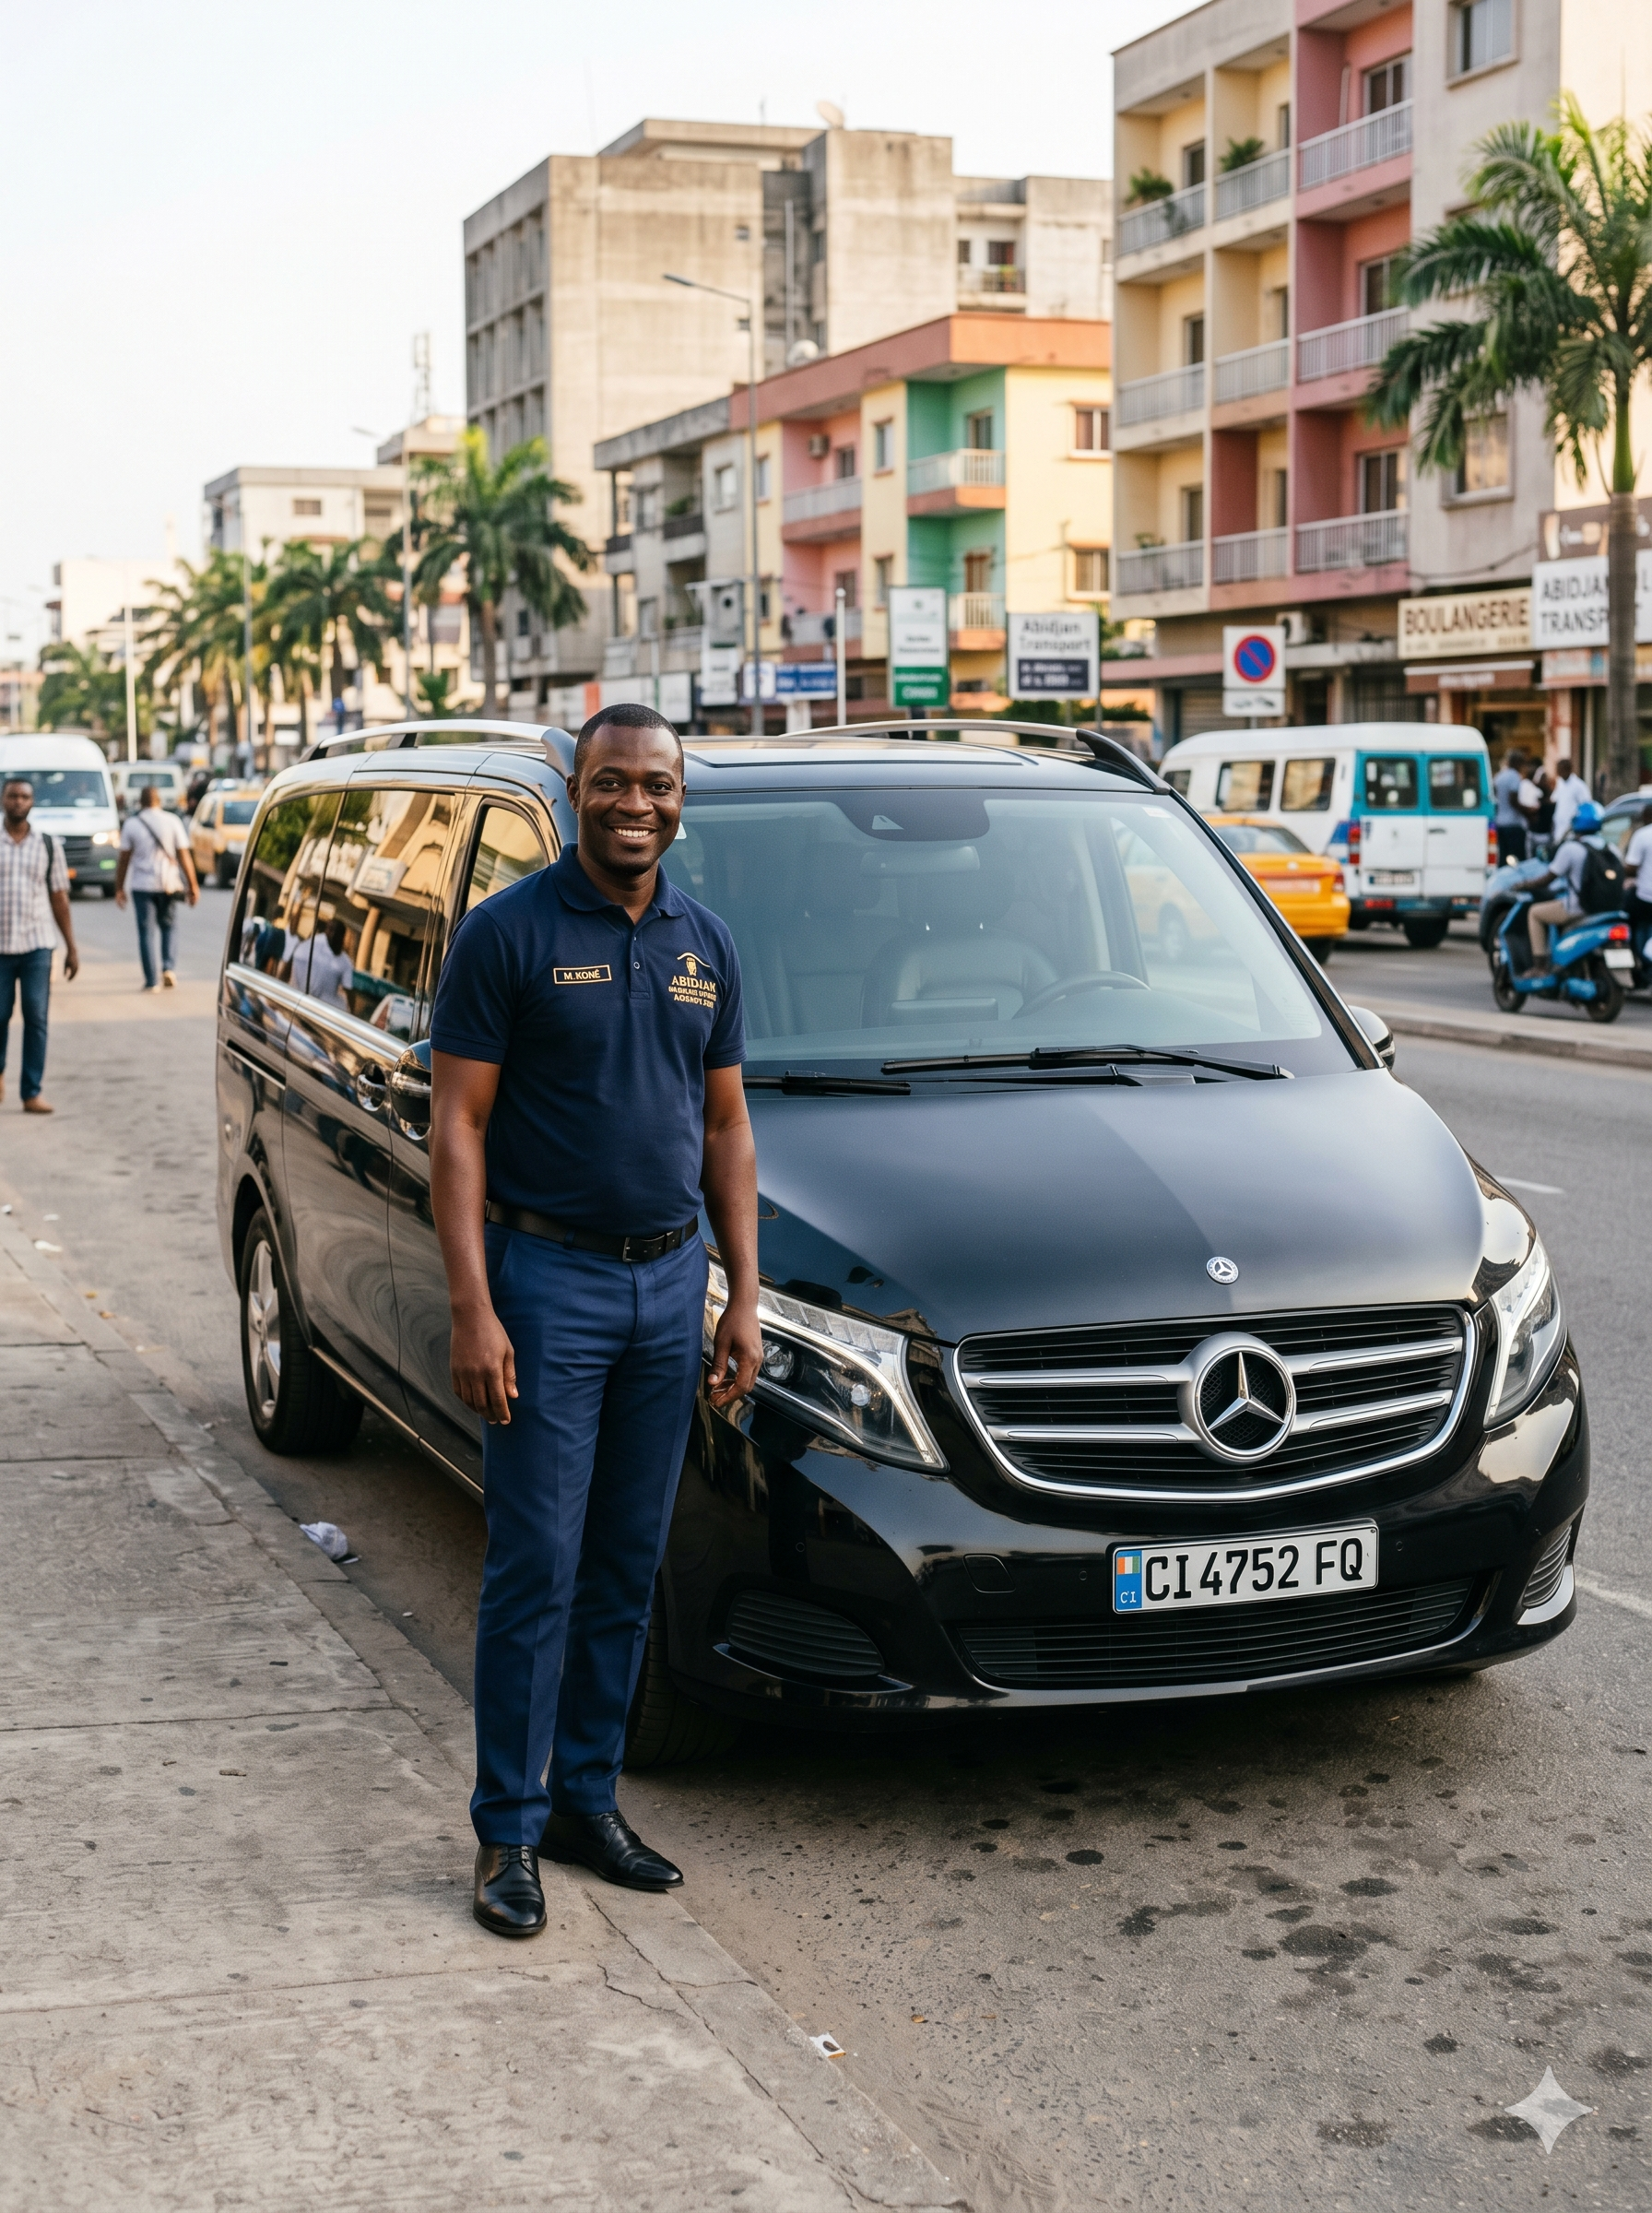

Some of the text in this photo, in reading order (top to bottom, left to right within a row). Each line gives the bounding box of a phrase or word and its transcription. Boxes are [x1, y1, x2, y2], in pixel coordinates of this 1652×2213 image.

[1541, 574, 1610, 602] ABIDJA
[1405, 598, 1529, 634] BOULANGERIE
[1146, 1537, 1363, 1602] CI 4752 FQ
[1120, 1591, 1137, 1604] CI
